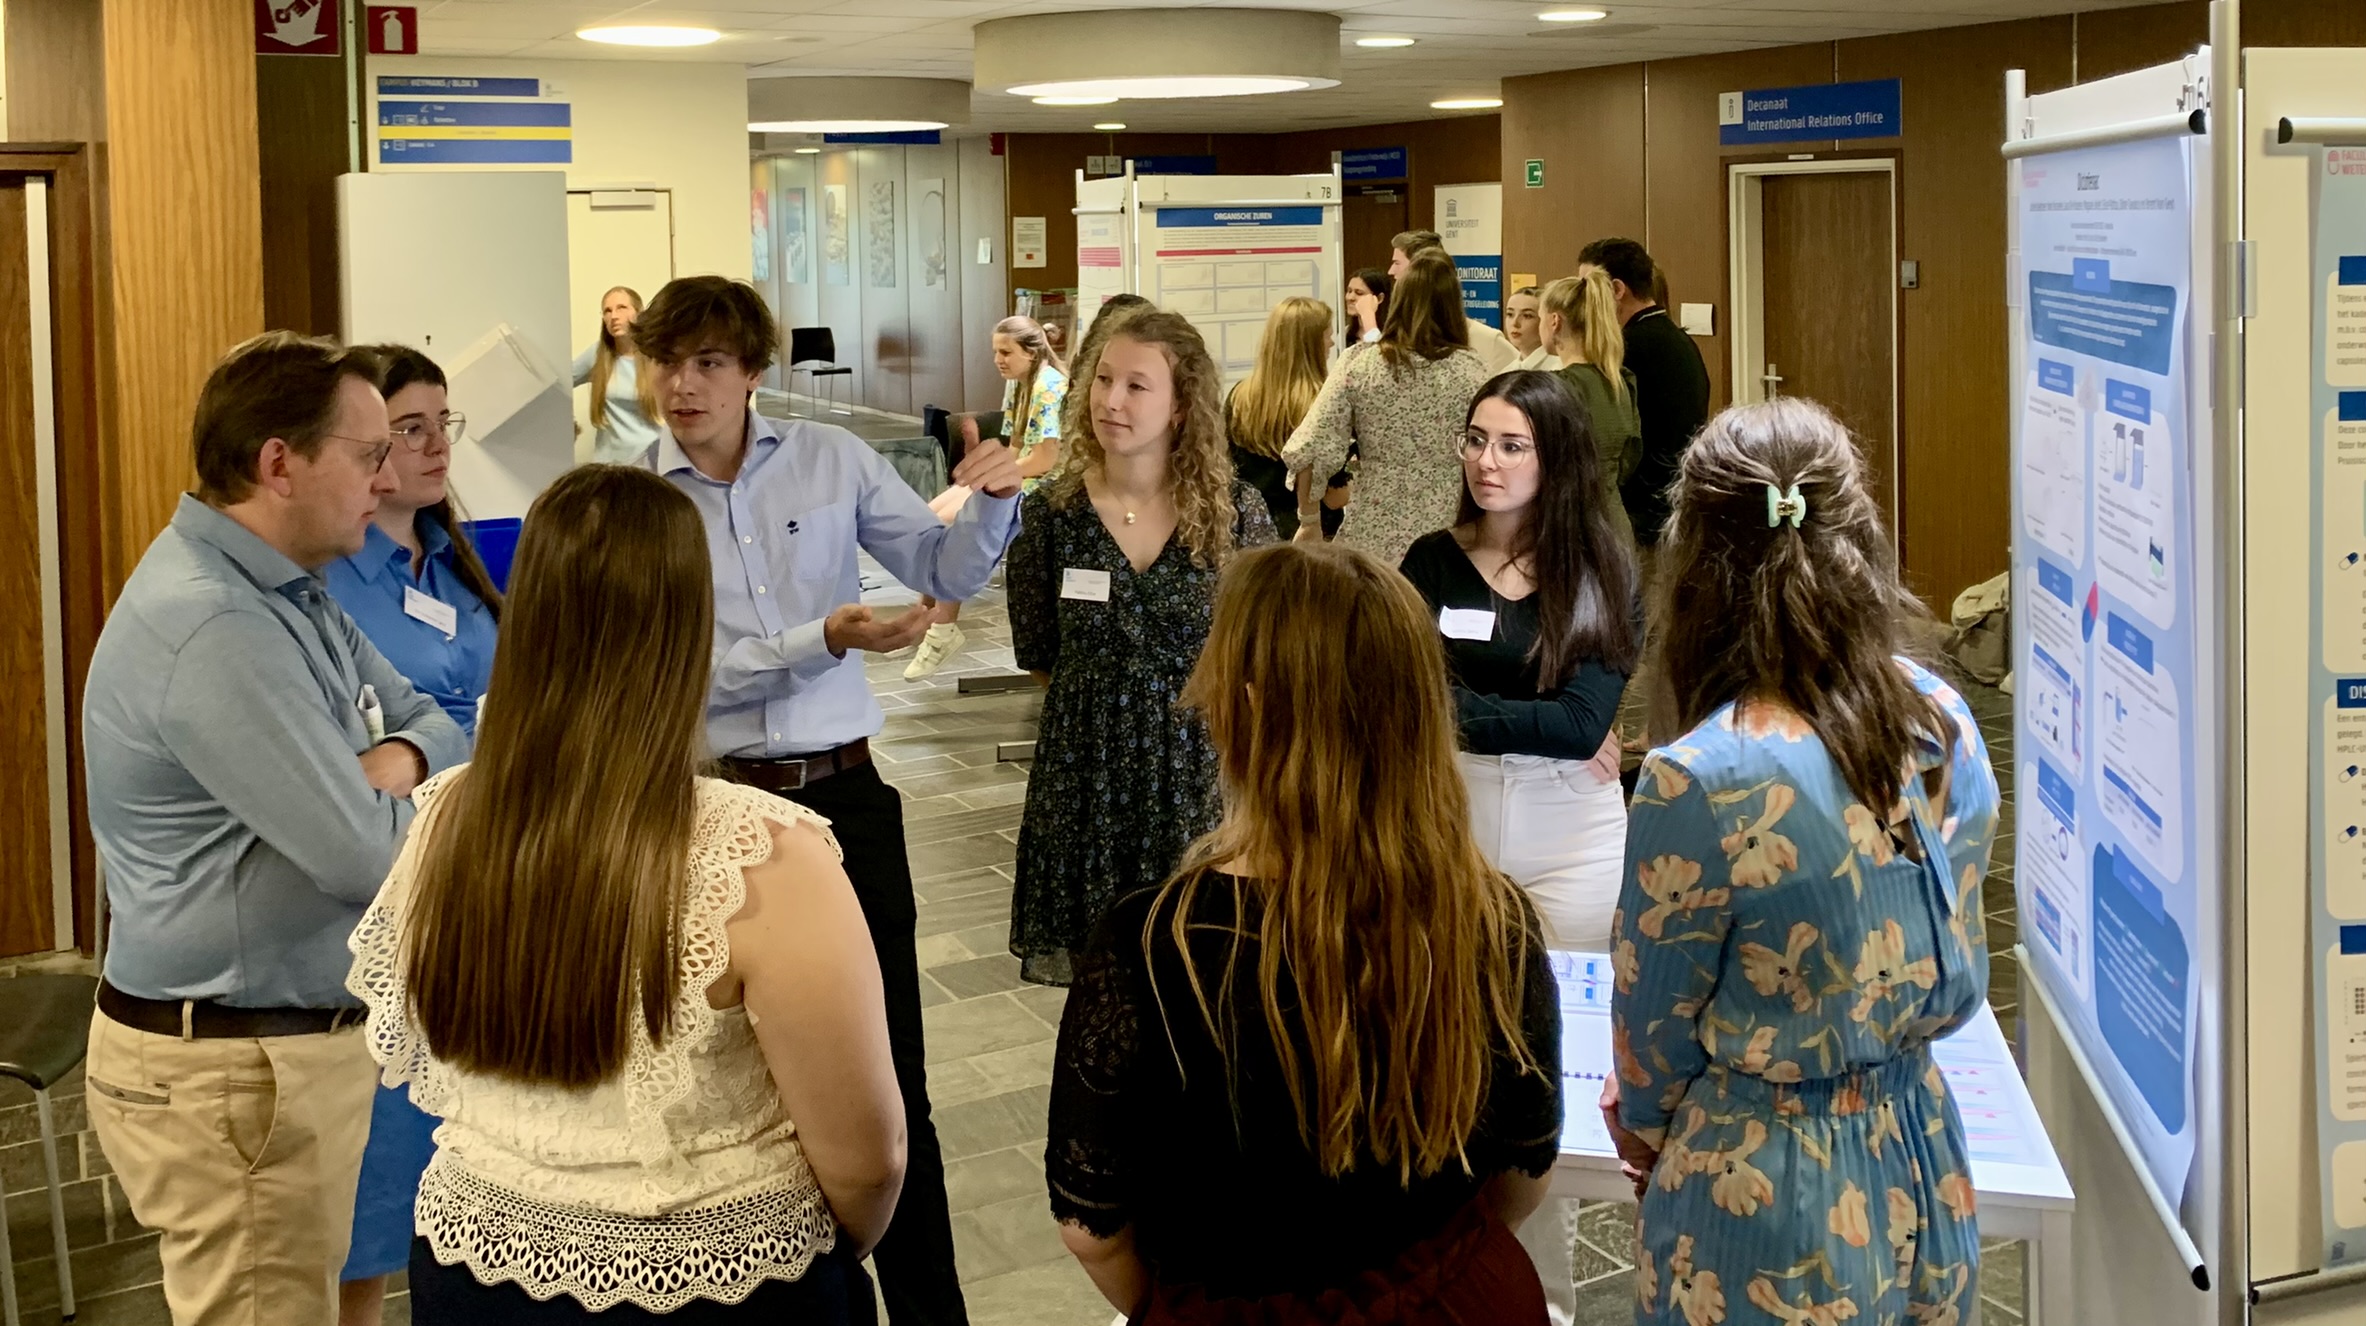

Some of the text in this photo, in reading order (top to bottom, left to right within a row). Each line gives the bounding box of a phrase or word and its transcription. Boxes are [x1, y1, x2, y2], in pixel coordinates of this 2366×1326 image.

[1747, 97, 1788, 112] Decanaat
[1747, 111, 1884, 132] International Relations Office
[1321, 186, 1332, 199] 7B
[1213, 212, 1273, 221] ORGANISCHE ZUREN
[1445, 219, 1479, 229] UNIVERSITEIT
[1445, 230, 1458, 239] GENT
[1455, 267, 1498, 279] ONITORAAT
